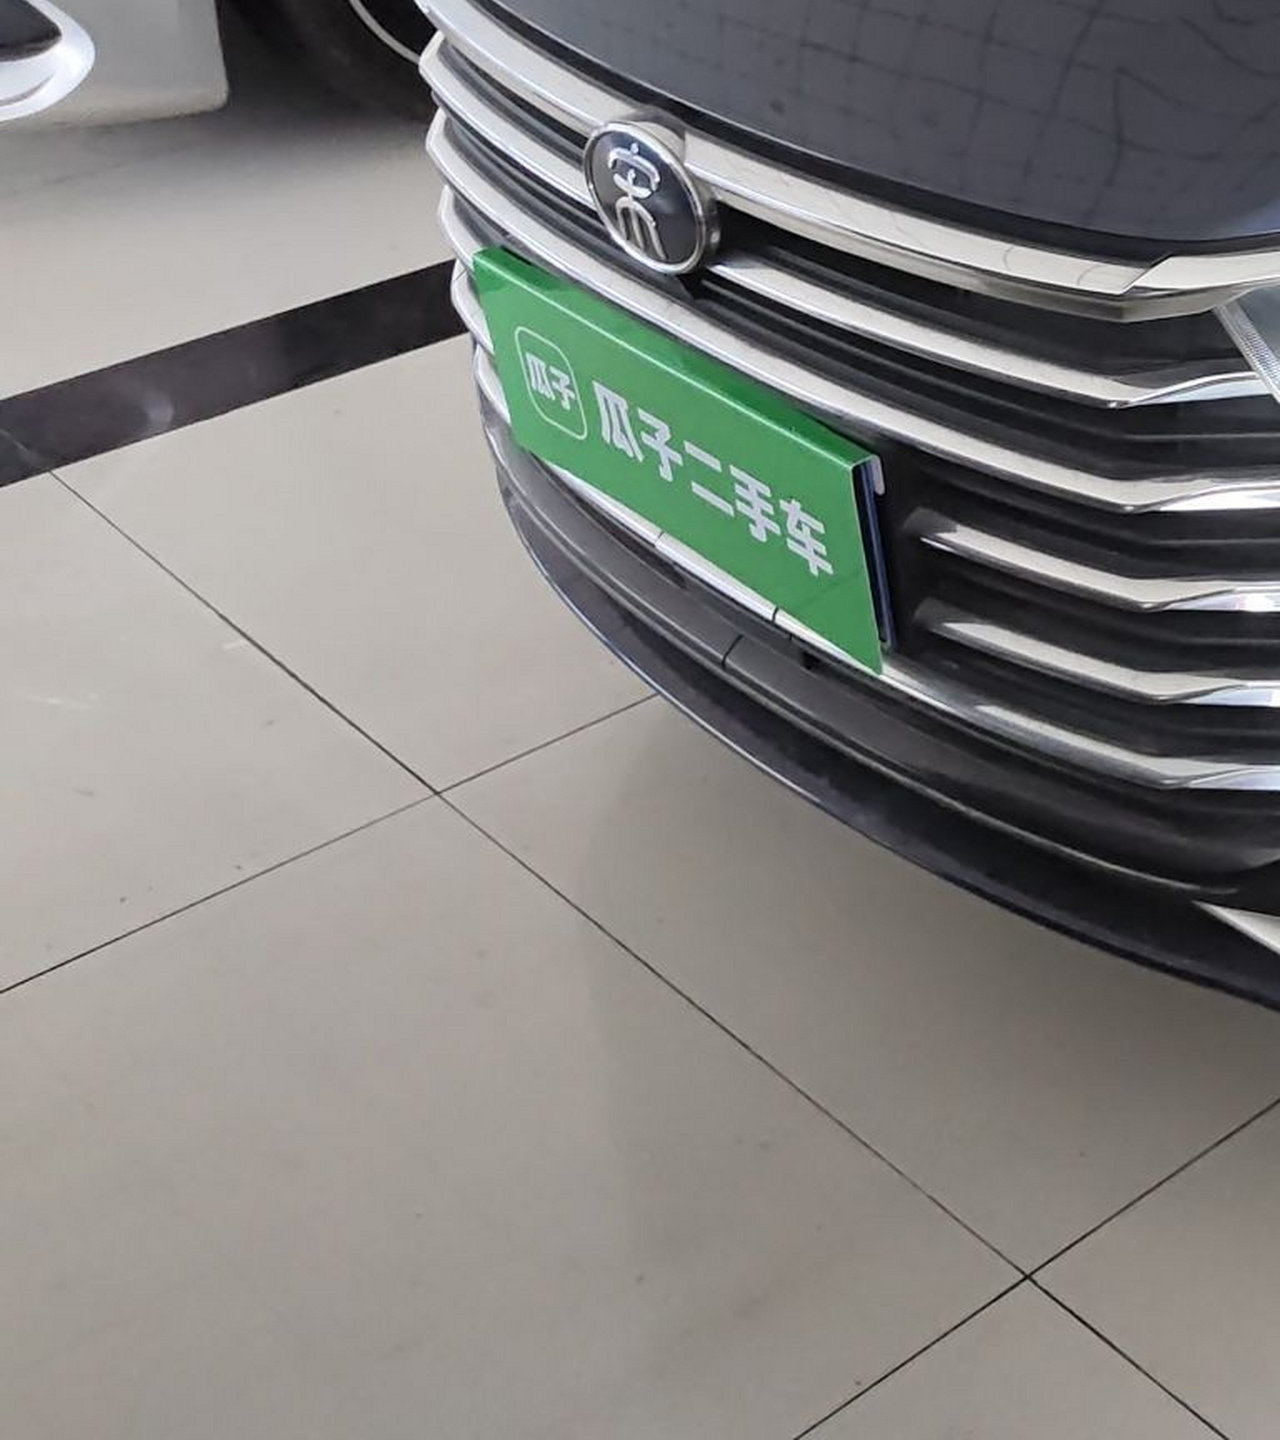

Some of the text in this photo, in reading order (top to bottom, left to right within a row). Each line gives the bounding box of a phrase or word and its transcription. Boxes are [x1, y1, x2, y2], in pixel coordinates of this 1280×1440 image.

[525, 352, 576, 411] 瓜子
[592, 380, 834, 578] 瓜子二手车
